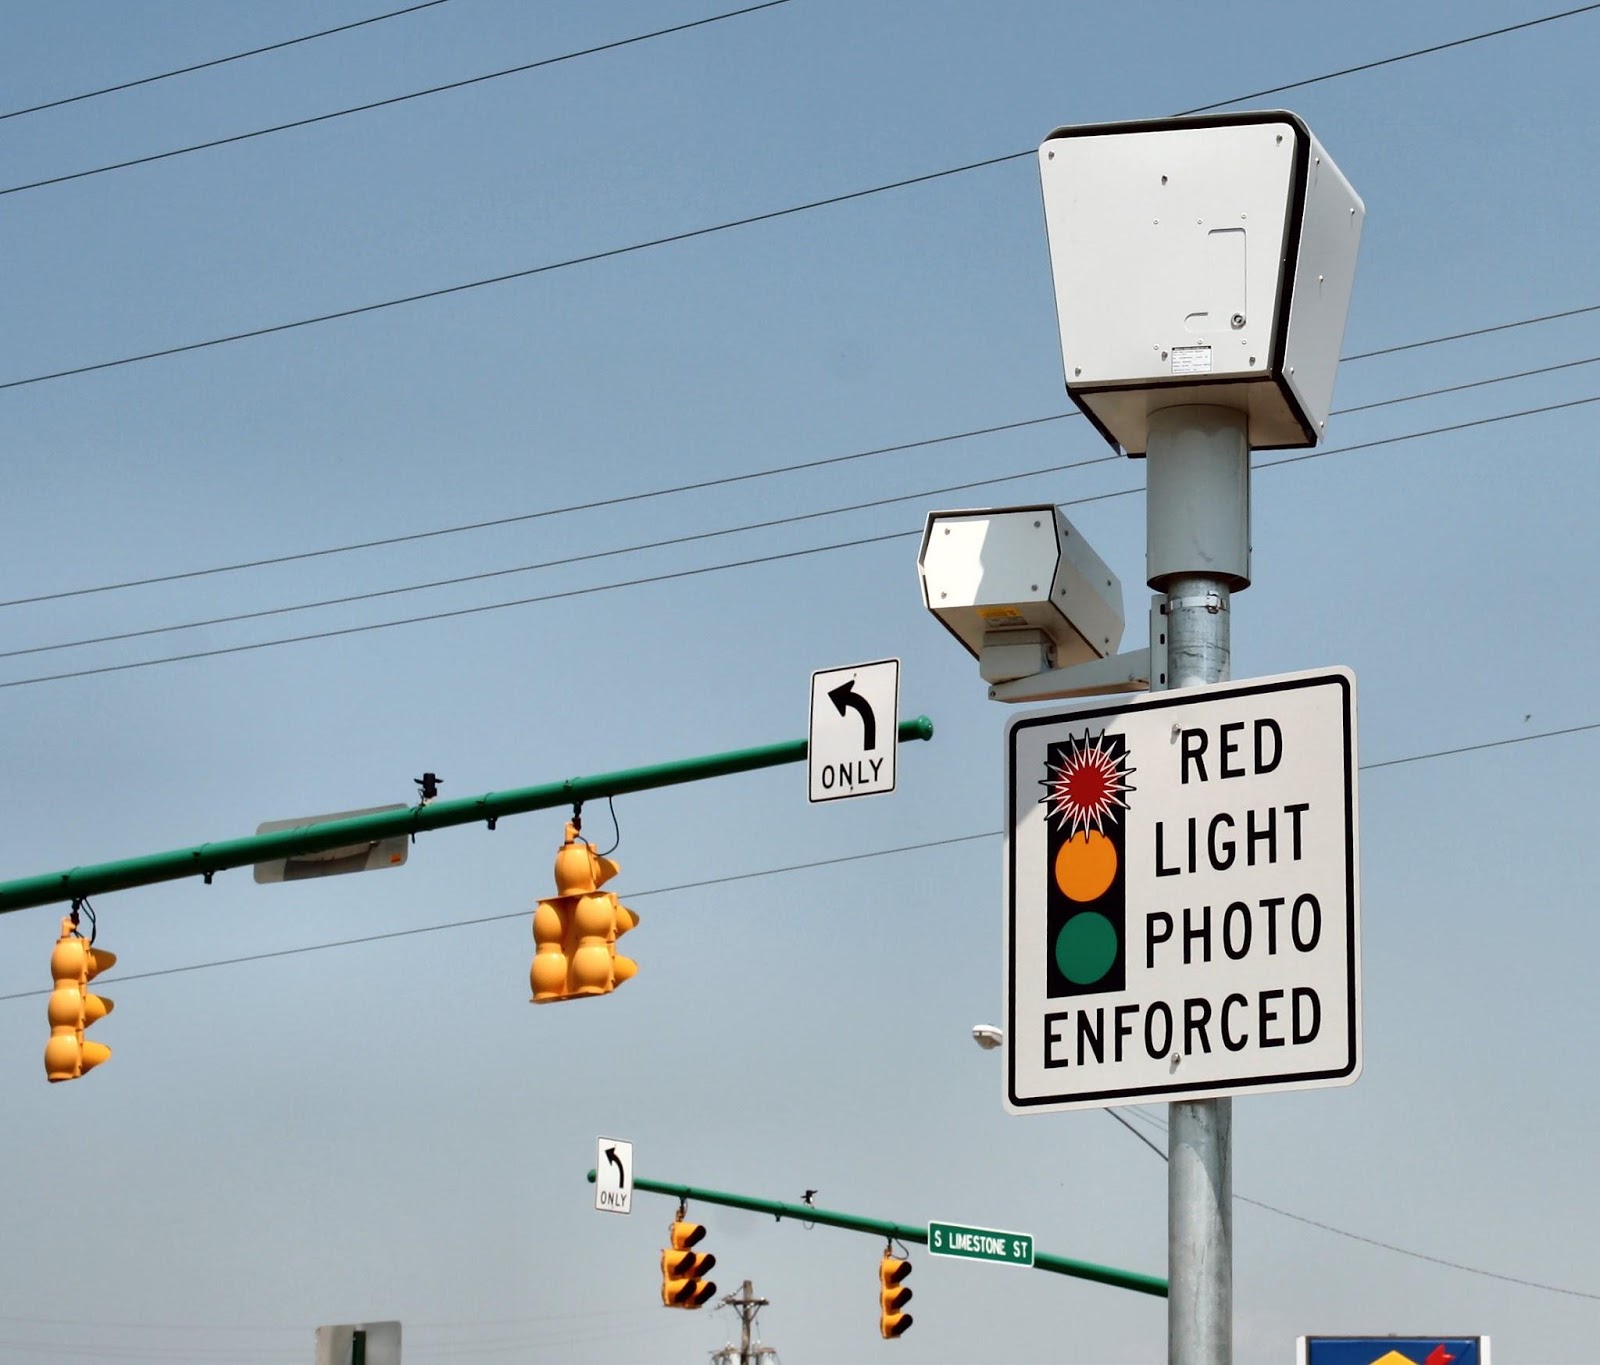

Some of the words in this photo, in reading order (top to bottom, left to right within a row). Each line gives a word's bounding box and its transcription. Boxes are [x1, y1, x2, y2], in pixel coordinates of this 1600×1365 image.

[822, 757, 884, 789] ONLY
[1181, 718, 1283, 785] RED
[1155, 802, 1310, 878] LIGHT
[1146, 893, 1322, 969] PHOTO
[1043, 986, 1321, 1070] ENFORCED
[600, 1190, 627, 1207] ONLY
[934, 1230, 942, 1247] S
[949, 1232, 1007, 1256] LIMESTONE
[1013, 1240, 1028, 1258] ST
